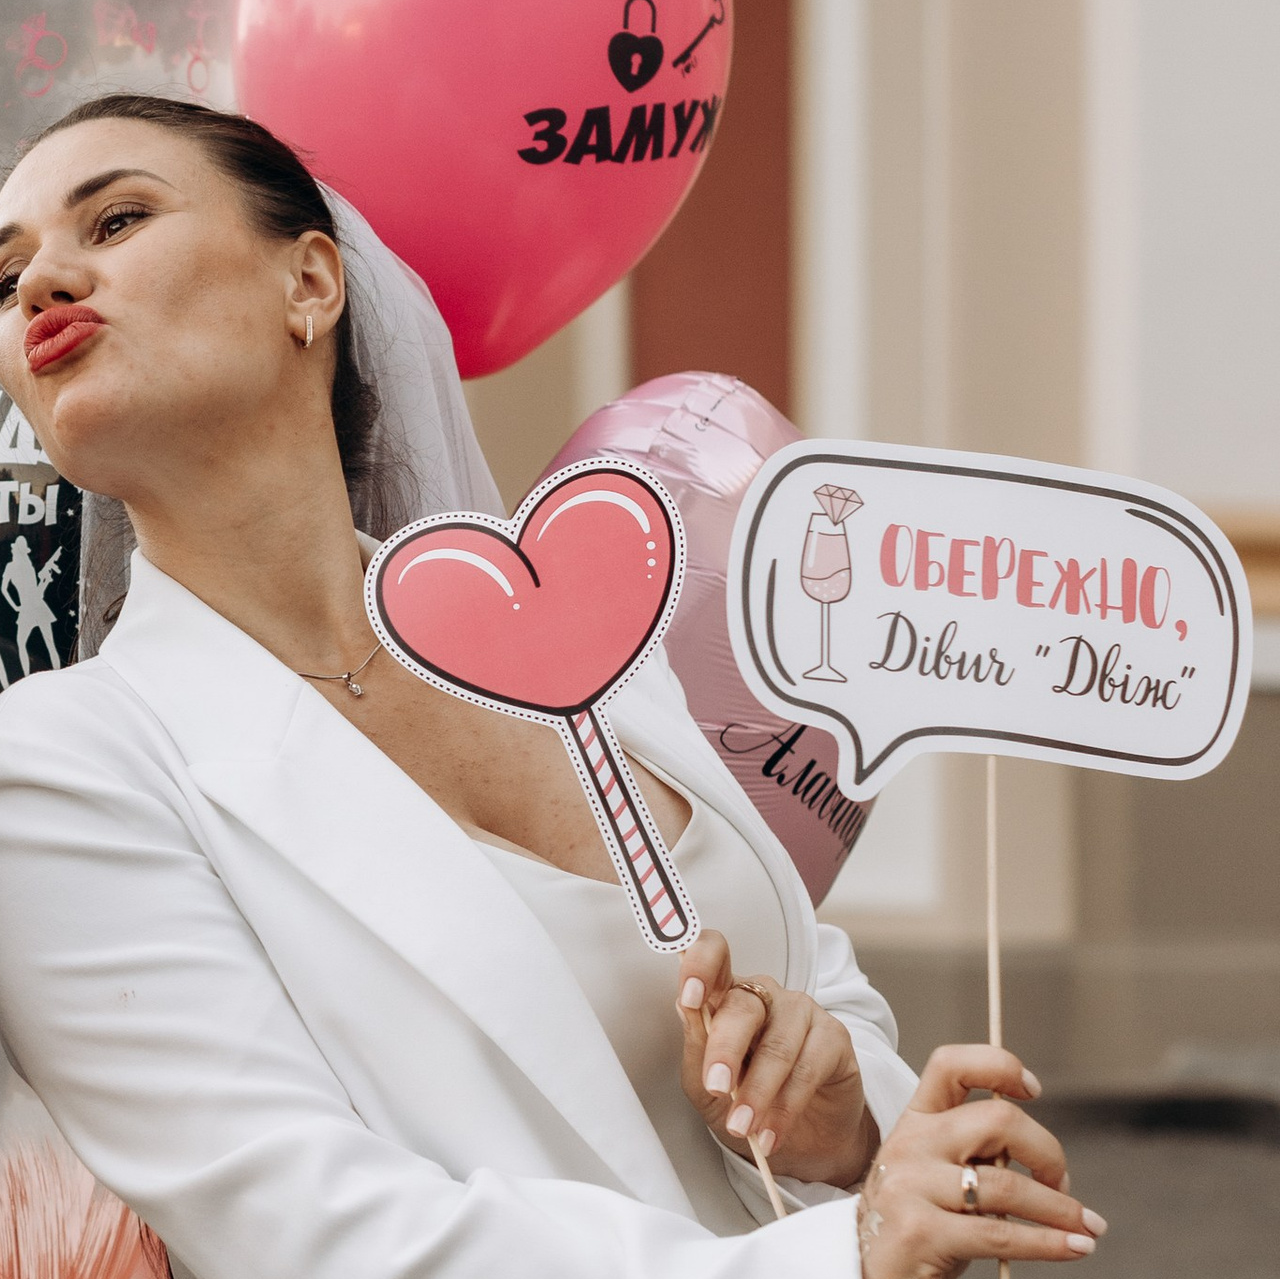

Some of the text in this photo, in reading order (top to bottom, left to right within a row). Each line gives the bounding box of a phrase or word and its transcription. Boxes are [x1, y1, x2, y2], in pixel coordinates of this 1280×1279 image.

[879, 523, 1189, 641] ОБЕРЕЖНО,
[869, 610, 1196, 710] Дівич "Двіж"
